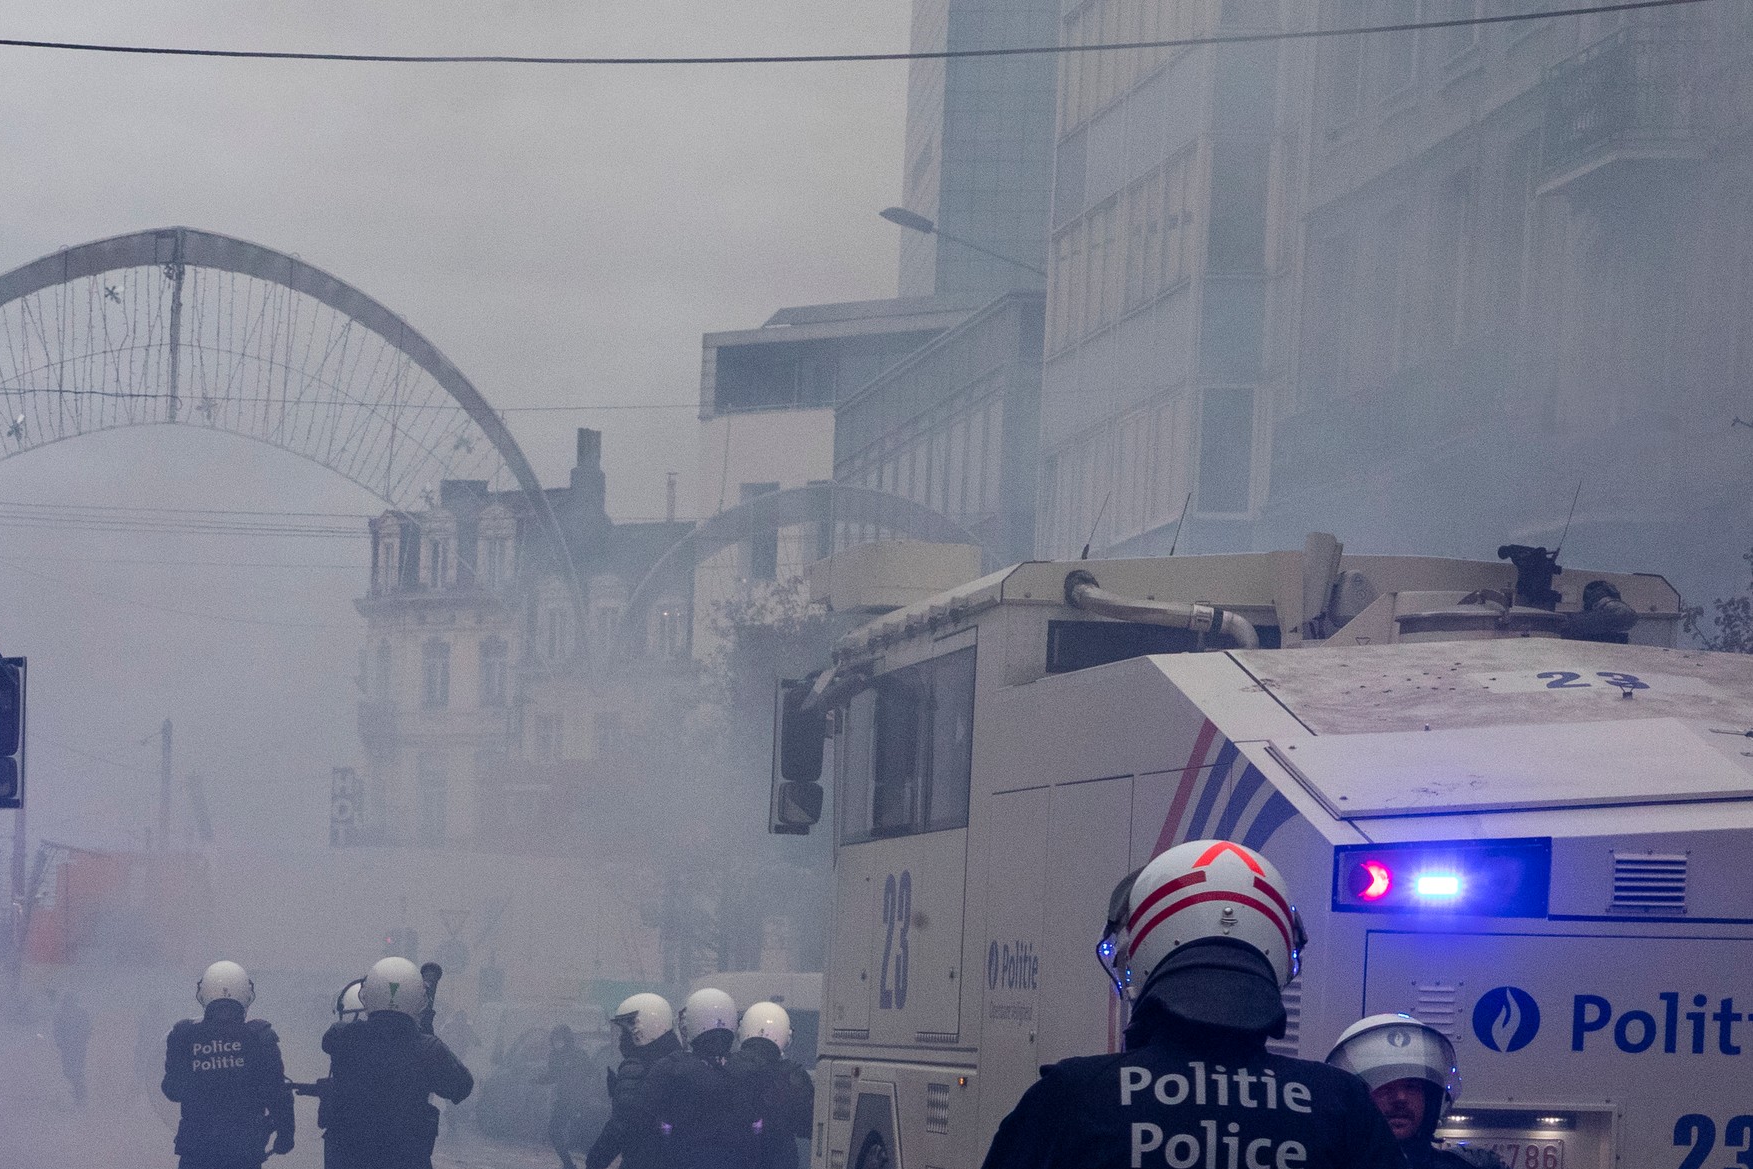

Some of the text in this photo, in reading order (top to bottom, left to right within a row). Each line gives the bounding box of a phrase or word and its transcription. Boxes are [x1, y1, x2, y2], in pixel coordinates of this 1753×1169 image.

[1537, 671, 1650, 689] 23
[879, 870, 912, 1010] 23
[1001, 940, 1039, 990] Politie
[193, 1039, 242, 1056] Police
[1572, 992, 1753, 1055] Polit
[192, 1055, 245, 1072] Politie
[1120, 1061, 1313, 1114] Politie
